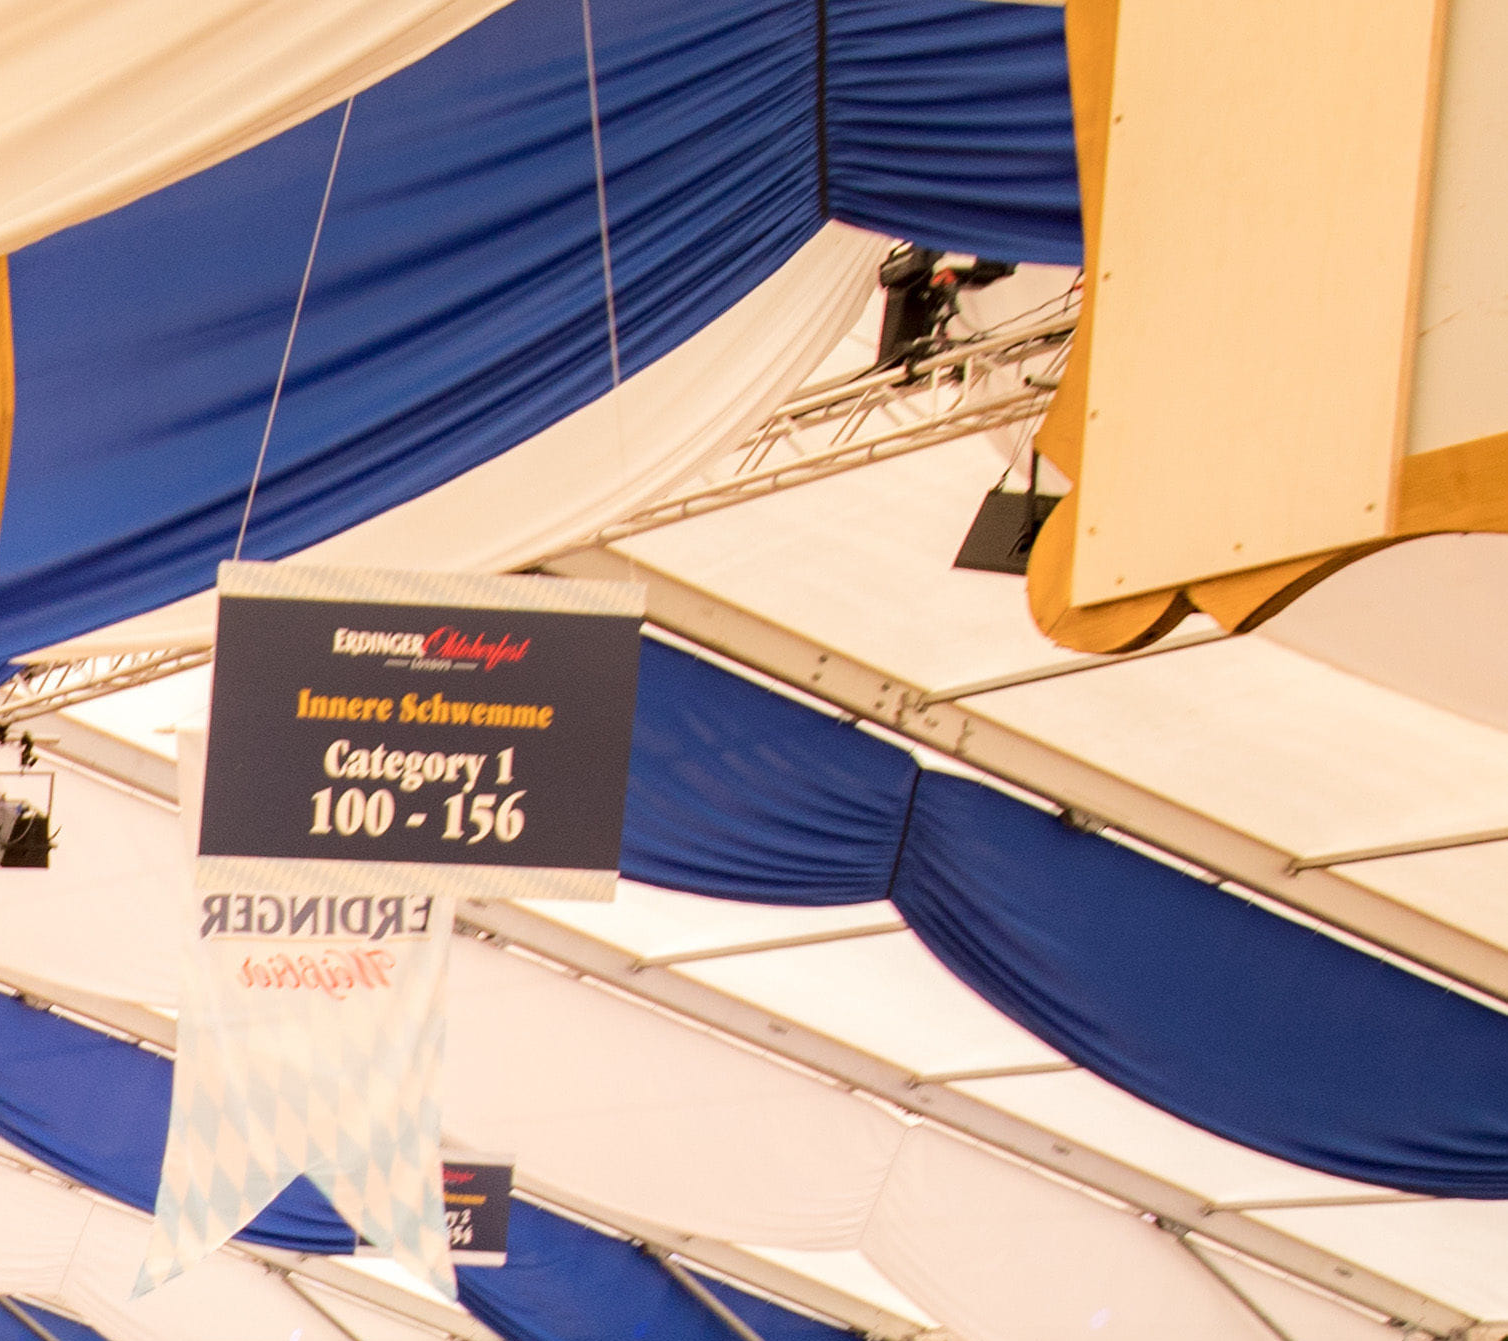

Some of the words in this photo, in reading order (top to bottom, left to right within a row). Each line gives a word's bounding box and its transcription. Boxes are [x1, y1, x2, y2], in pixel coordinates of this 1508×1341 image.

[331, 627, 425, 657] ERDINGER
[422, 625, 532, 672] Oktoberfest
[296, 687, 394, 722] Innere
[398, 692, 554, 729] Schwemme
[324, 738, 488, 793] Category
[495, 746, 515, 785] 1
[308, 786, 395, 837] 100
[405, 812, 428, 828] -
[441, 789, 528, 845] 156
